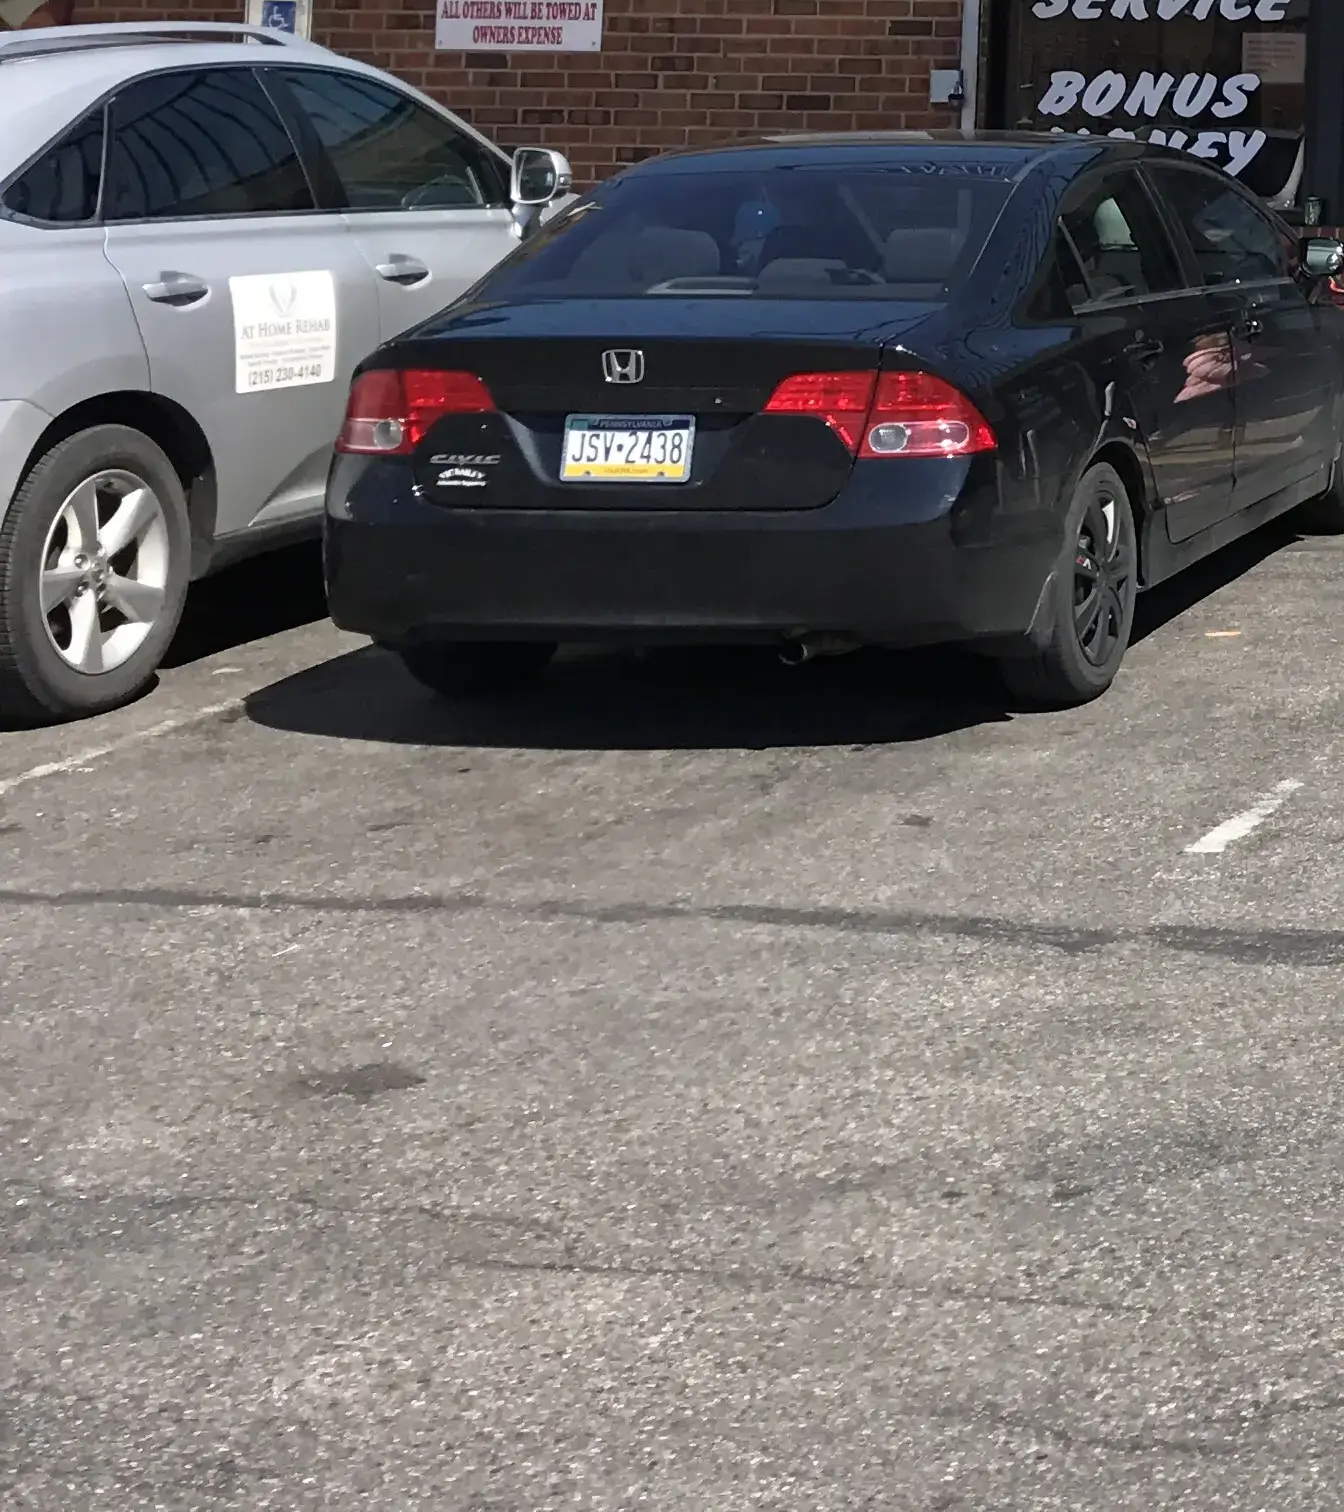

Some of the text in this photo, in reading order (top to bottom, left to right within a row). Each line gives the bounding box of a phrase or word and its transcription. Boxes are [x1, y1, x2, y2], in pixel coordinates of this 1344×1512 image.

[441, 0, 597, 21] ALL OTHERS WILL BE TOWED AT
[472, 25, 563, 45] OWNERS EXPENSE
[1037, 69, 1261, 118] BONUS
[600, 419, 663, 429] PENNSYLVANIA
[429, 454, 501, 465] CIVIC
